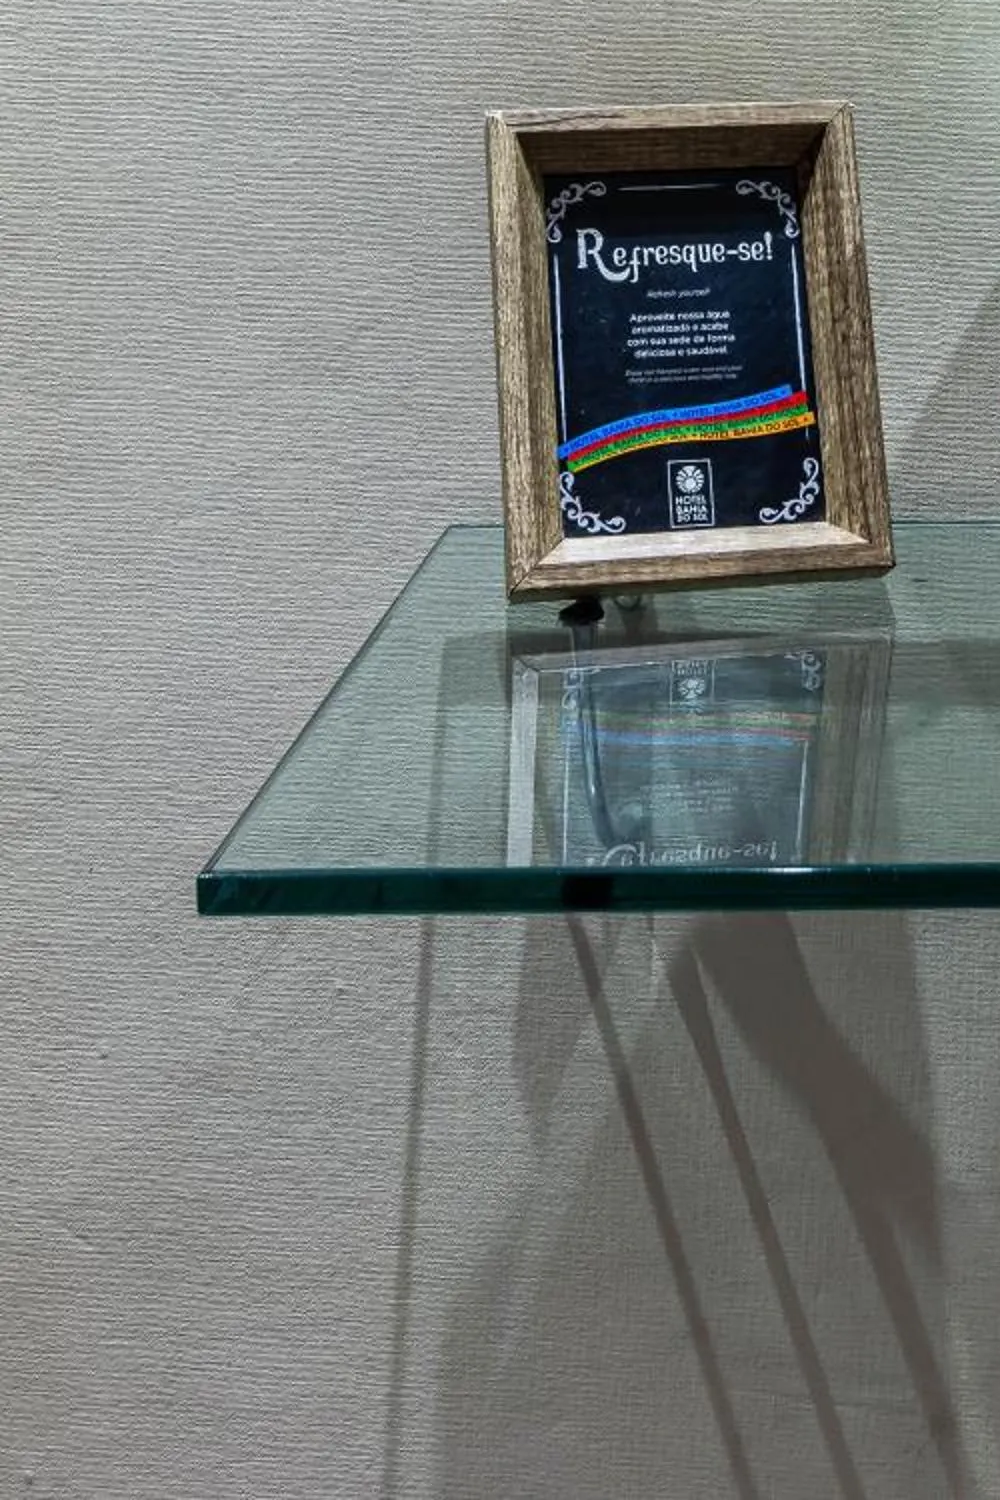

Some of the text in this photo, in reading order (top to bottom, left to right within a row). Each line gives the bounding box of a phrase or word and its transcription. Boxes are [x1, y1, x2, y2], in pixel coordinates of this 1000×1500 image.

[576, 228, 773, 283] Refresque-se!
[630, 313, 675, 323] Aproveite
[677, 311, 705, 321] nossa
[700, 323, 729, 332] acabe
[627, 333, 736, 347] com sua sede de forma
[633, 348, 676, 359] deliciosa
[675, 495, 706, 505] HOTEL
[675, 504, 708, 514] BAHIA
[678, 512, 709, 522] DO SOL
